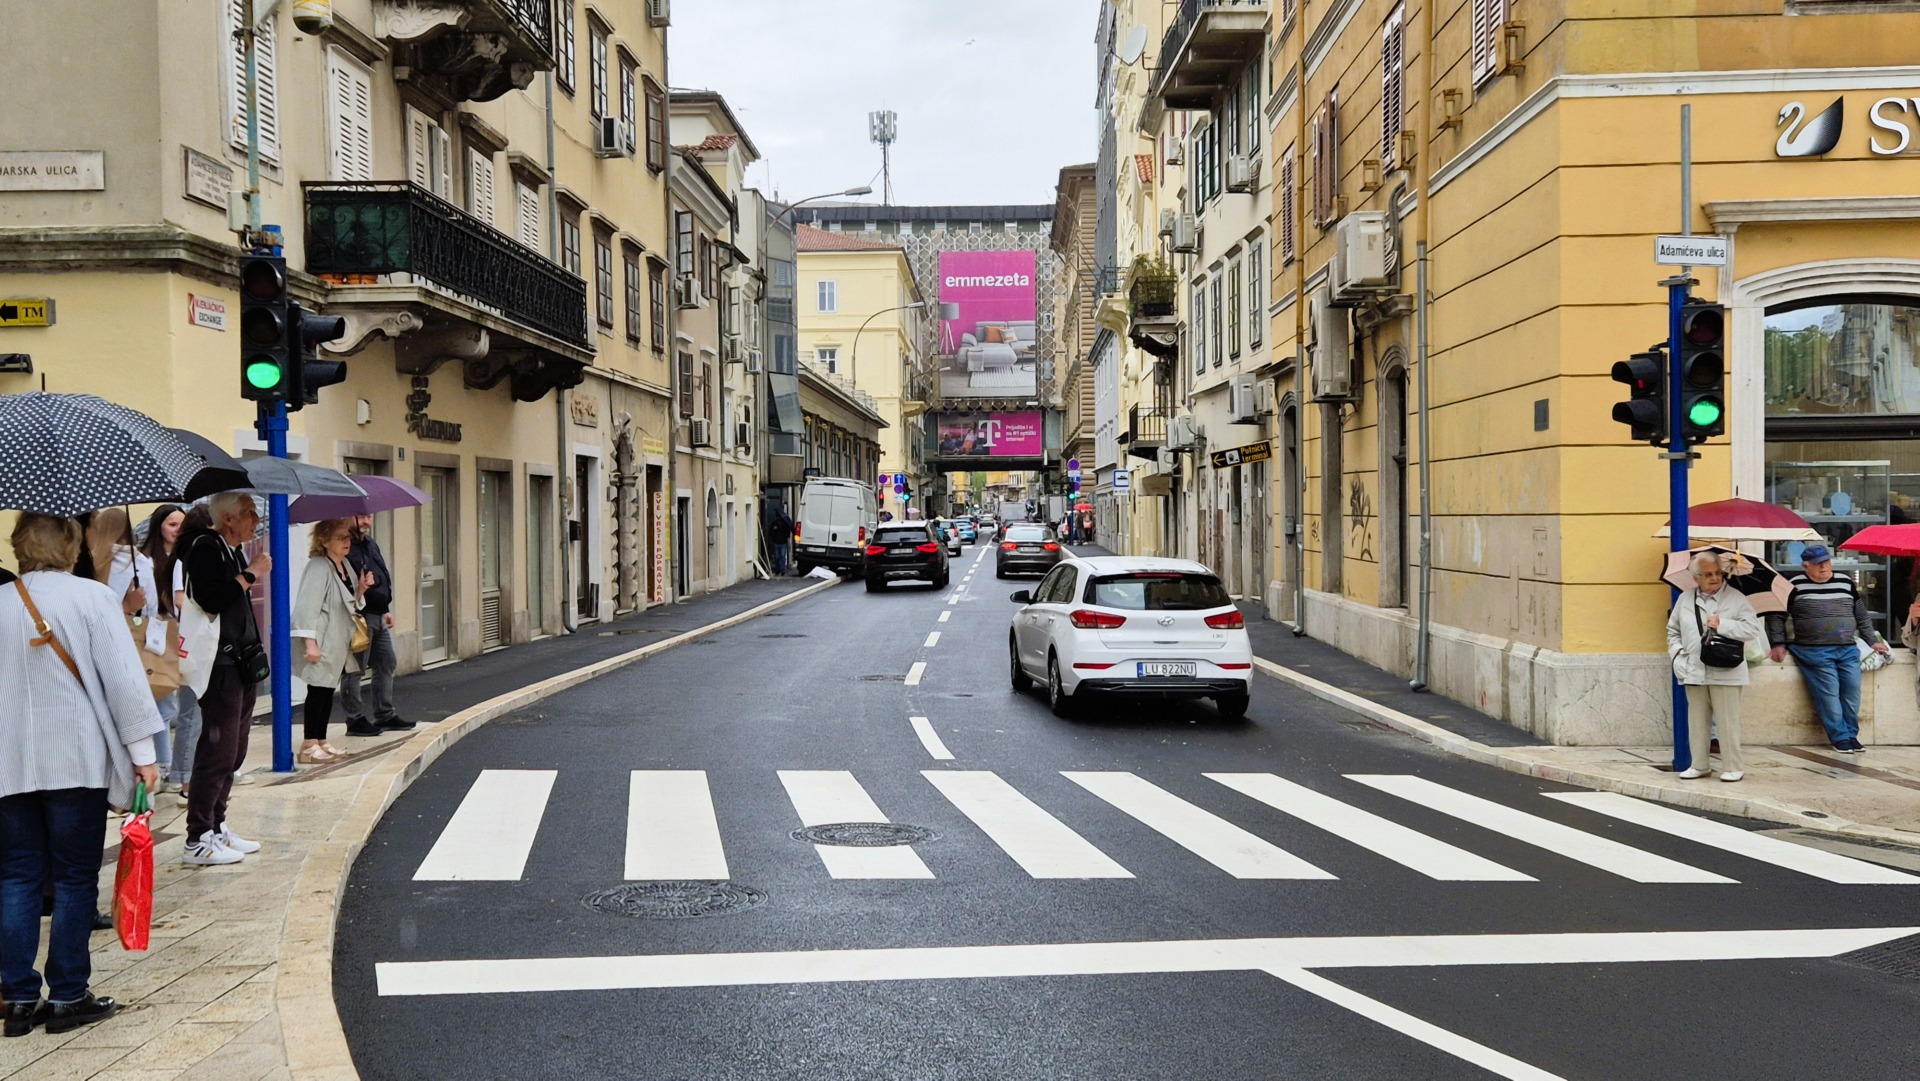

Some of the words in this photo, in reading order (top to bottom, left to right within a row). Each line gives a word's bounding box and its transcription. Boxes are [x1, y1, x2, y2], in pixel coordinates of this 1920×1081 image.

[46, 165, 78, 175] ULICA
[1660, 244, 1704, 257] Adamićeva
[1707, 246, 1725, 258] ulica
[945, 272, 1029, 287] emmezeta
[22, 306, 45, 318] TM
[199, 312, 222, 325] EXCHANGE
[1242, 450, 1269, 463] terminal
[1145, 664, 1159, 675] LU
[1161, 664, 1194, 675] 822NU
